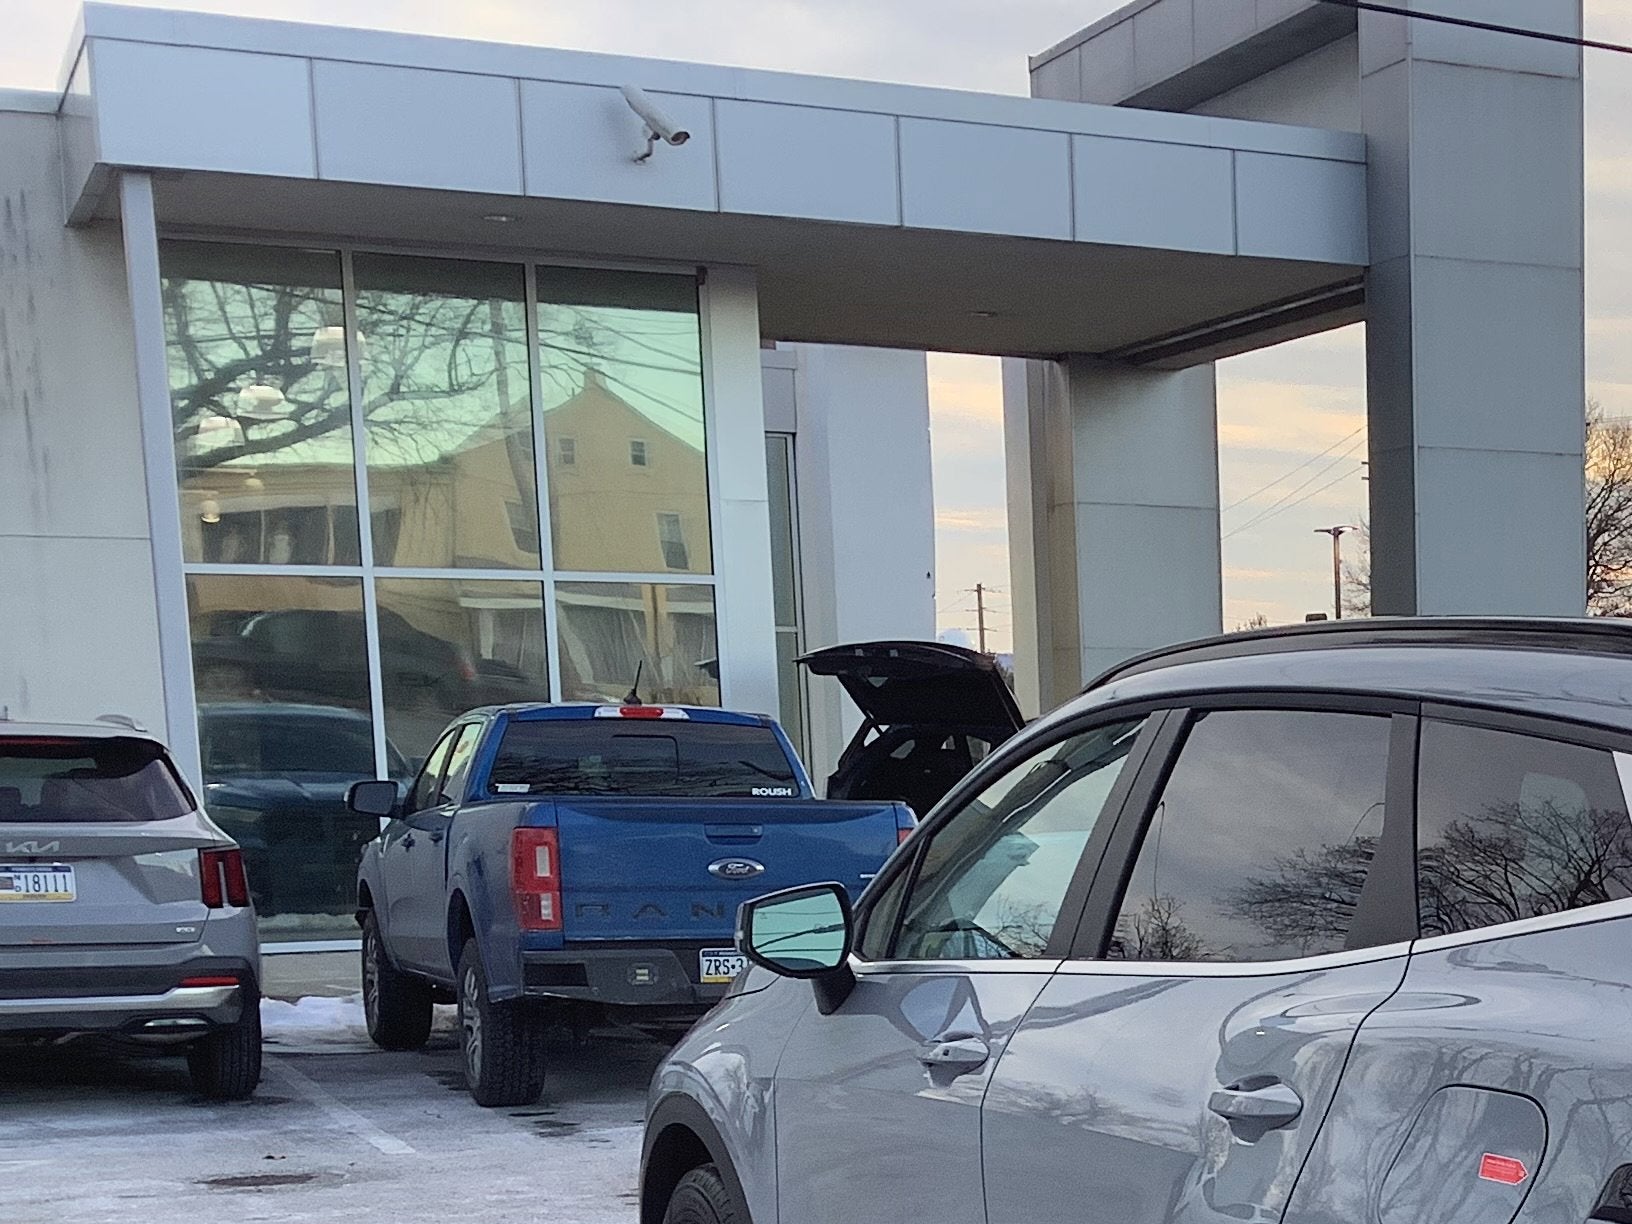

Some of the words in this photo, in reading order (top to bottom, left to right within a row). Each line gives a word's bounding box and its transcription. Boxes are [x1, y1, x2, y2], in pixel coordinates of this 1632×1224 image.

[751, 787, 792, 797] ROUSH
[5, 840, 61, 853] KIA
[725, 862, 751, 875] Ford
[575, 902, 726, 919] RAN
